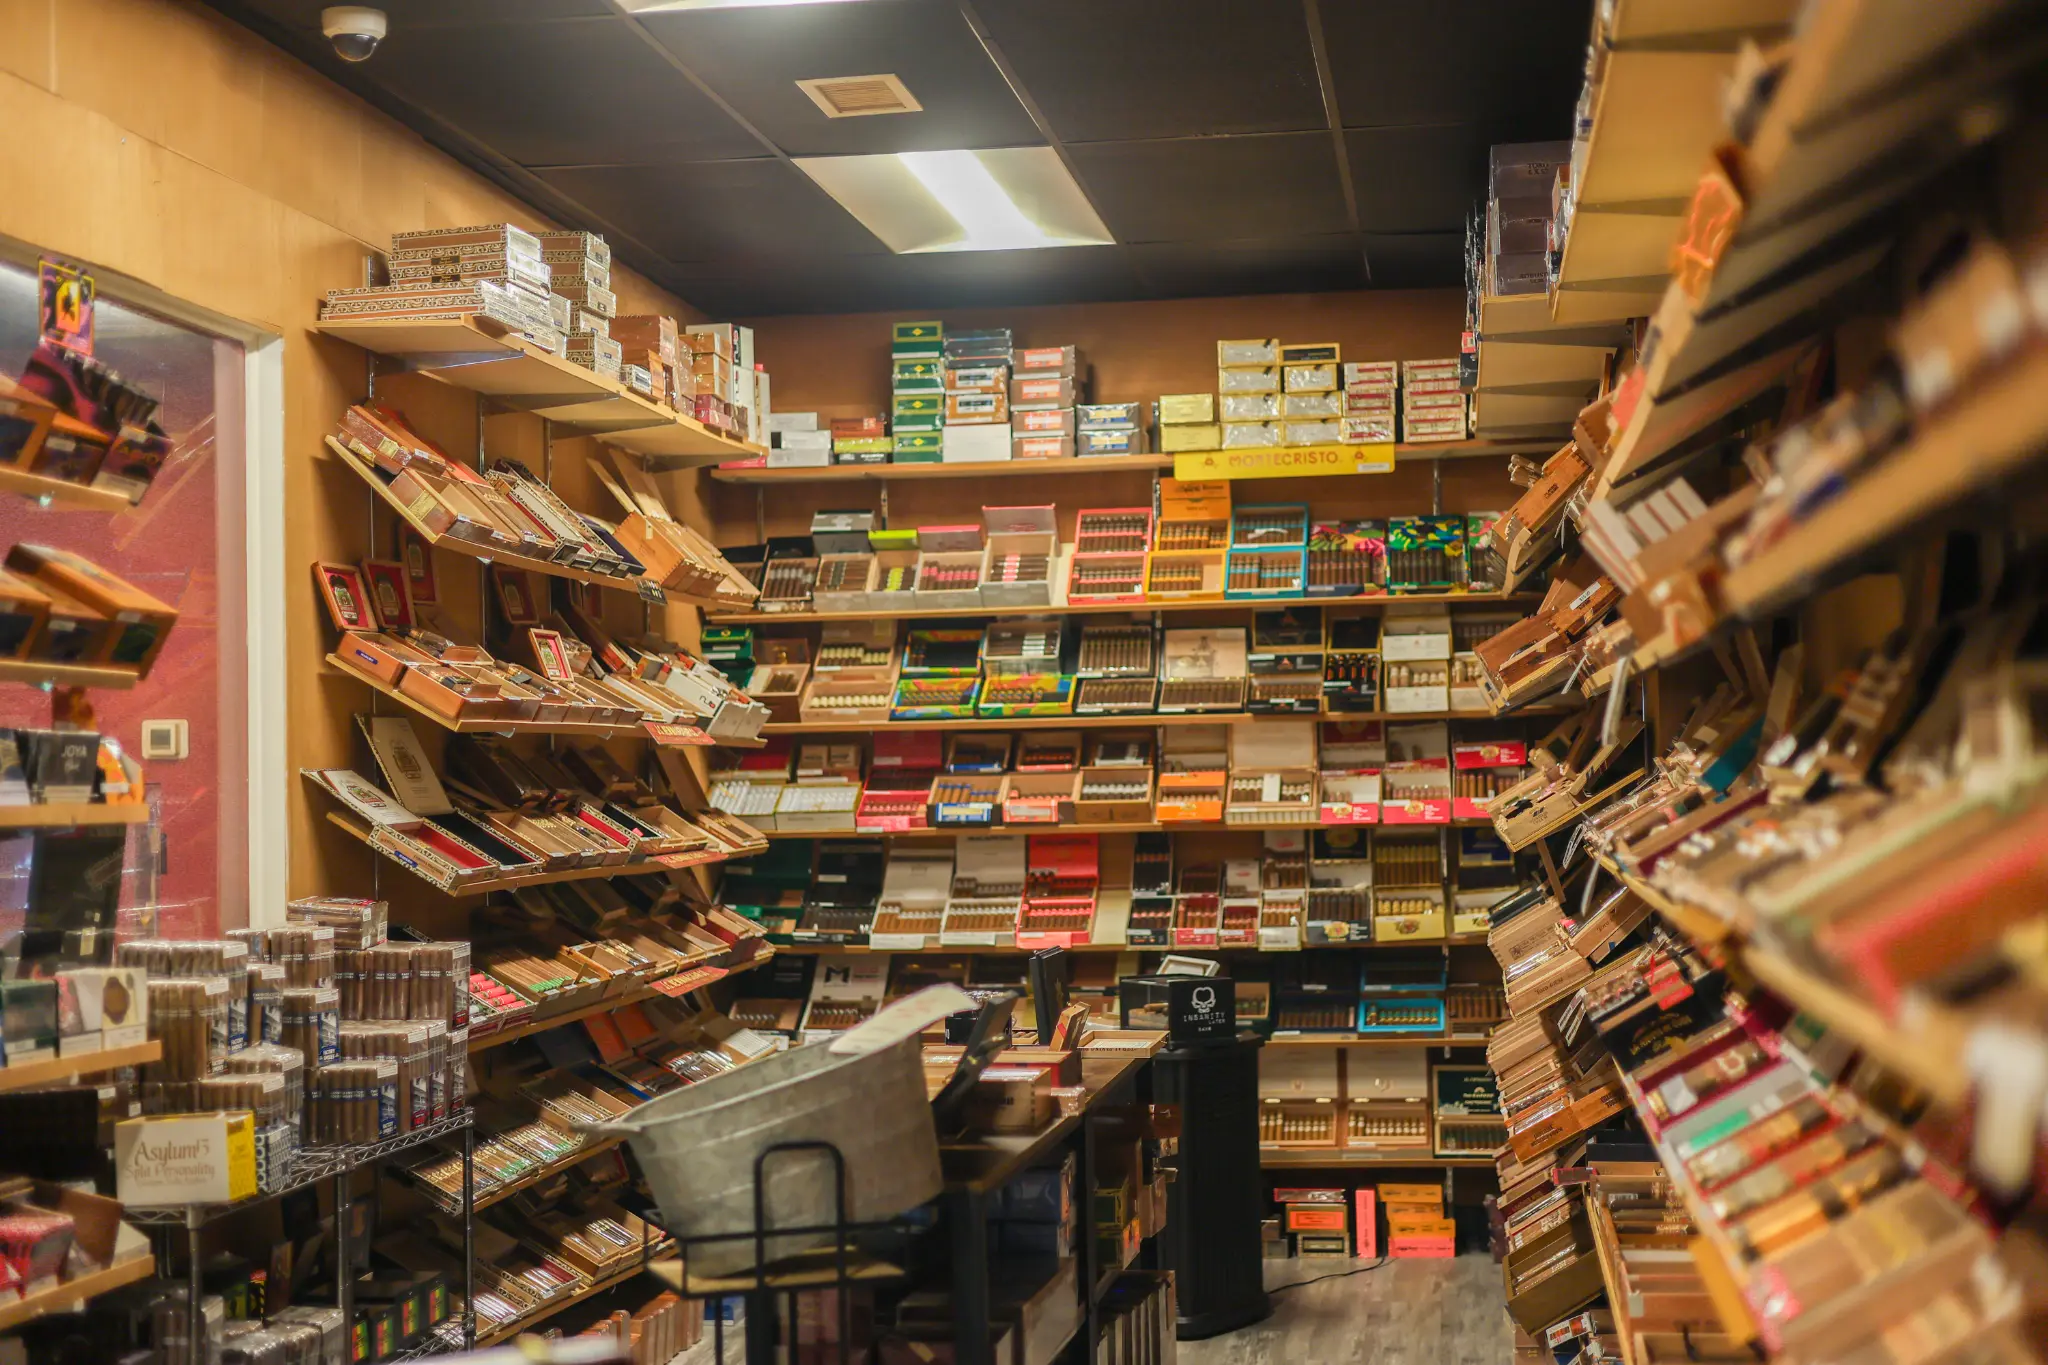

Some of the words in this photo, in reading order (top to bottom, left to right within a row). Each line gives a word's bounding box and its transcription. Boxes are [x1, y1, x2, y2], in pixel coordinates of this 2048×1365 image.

[1228, 451, 1340, 468] MONTECRISTO
[61, 744, 88, 758] JOYA
[1183, 1012, 1226, 1022] INSANITY
